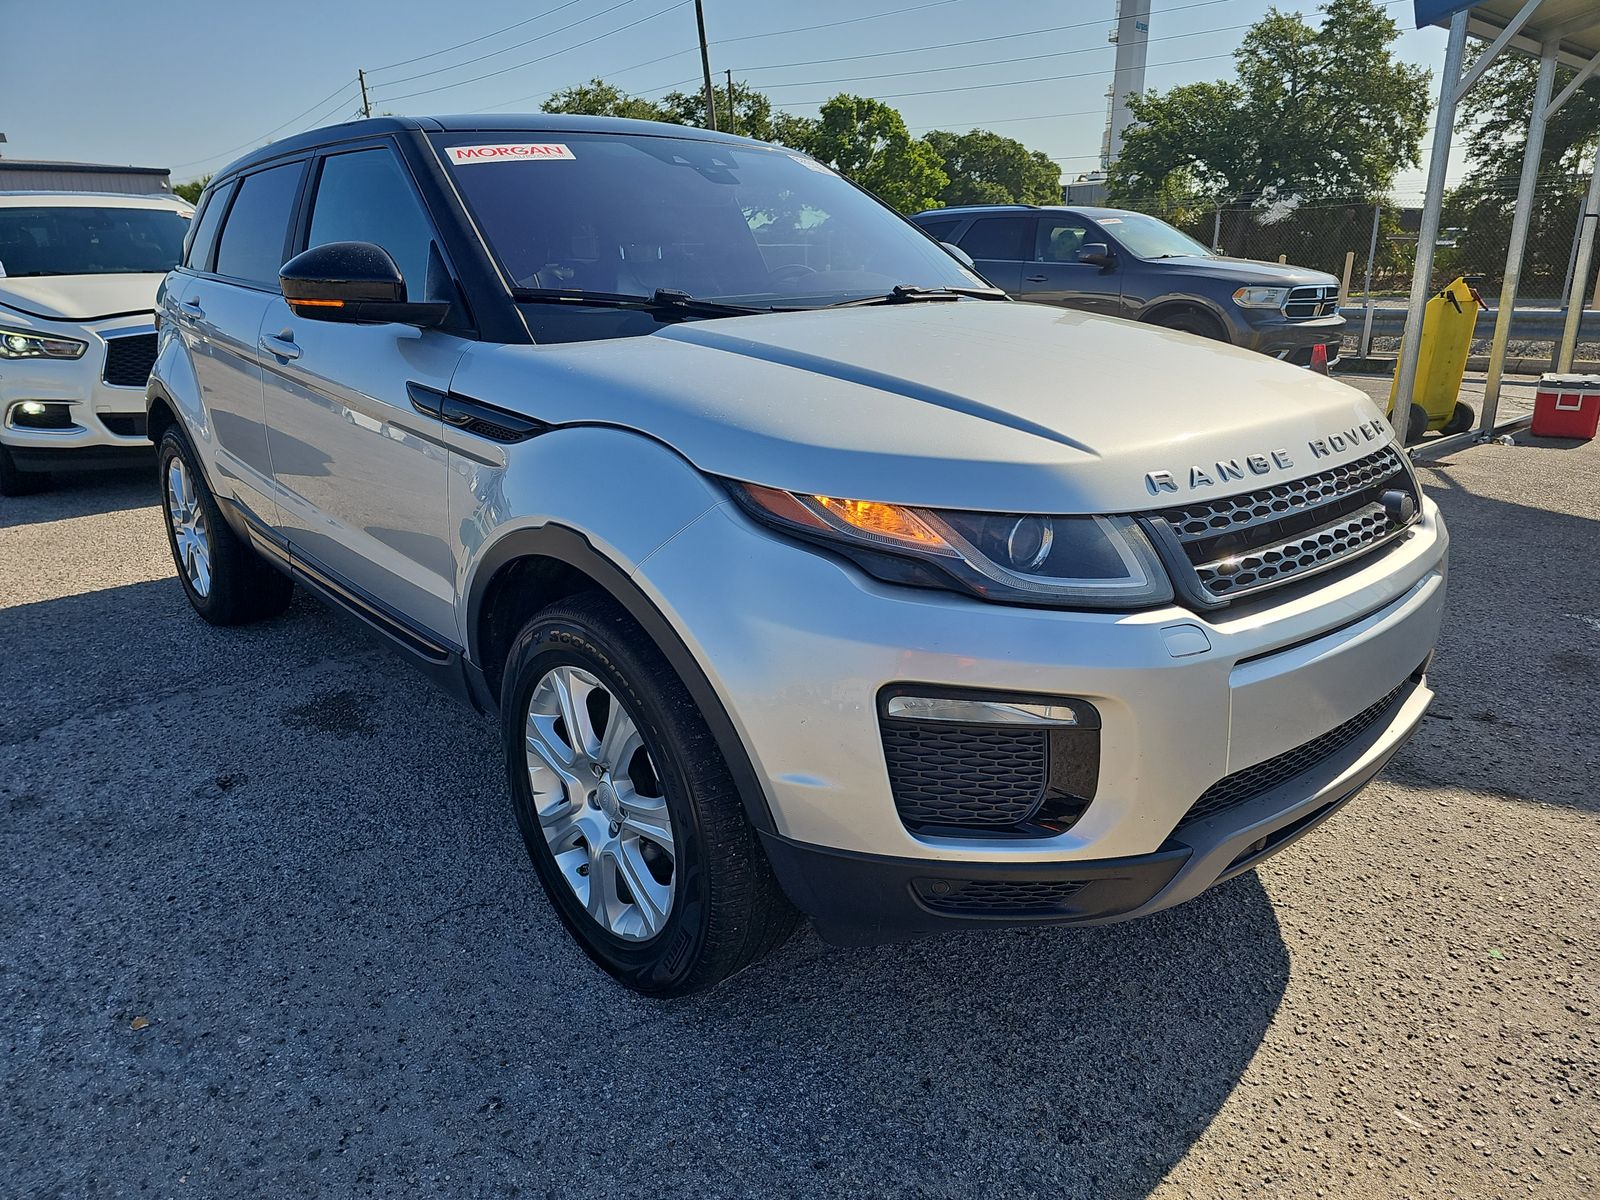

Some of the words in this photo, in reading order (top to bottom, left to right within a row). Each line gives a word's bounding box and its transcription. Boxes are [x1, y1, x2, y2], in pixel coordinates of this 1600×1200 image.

[456, 146, 563, 159] MORGAN
[1145, 448, 1295, 496] RANGE
[1308, 419, 1385, 459] ROVER
